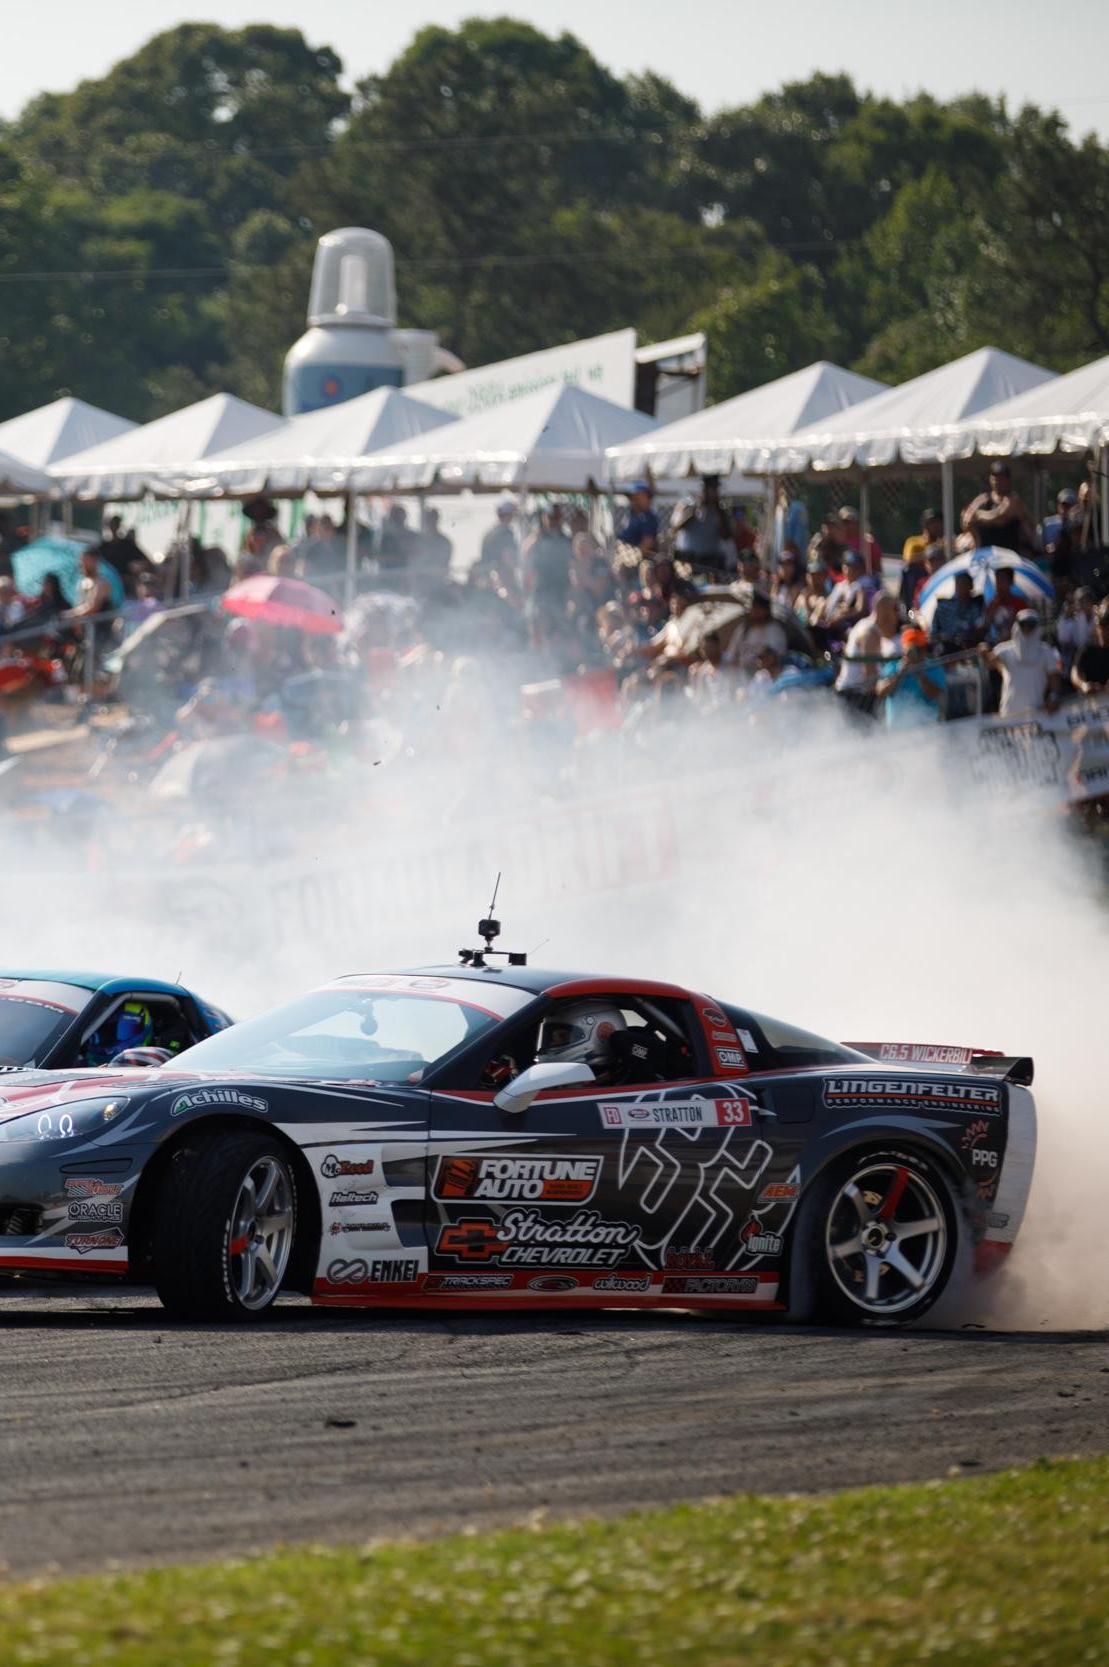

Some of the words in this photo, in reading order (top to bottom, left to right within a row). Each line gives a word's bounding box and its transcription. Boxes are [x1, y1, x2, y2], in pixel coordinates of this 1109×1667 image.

[719, 1051, 742, 1064] OMP
[881, 1044, 909, 1061] C6.5
[828, 1080, 999, 1102] LINGENFELTER
[173, 1090, 266, 1114] Achilles
[653, 1106, 703, 1123] STRATTON
[723, 1101, 745, 1123] 33
[972, 1149, 998, 1167] PPG
[478, 1160, 598, 1181] FORTUNE
[330, 1192, 378, 1203] Haltech
[474, 1180, 544, 1199] AUTO
[69, 1202, 121, 1217] ORACLE
[497, 1211, 639, 1245] Stratton
[747, 1233, 781, 1253] ignite
[501, 1246, 626, 1265] CHEVROLET
[370, 1260, 420, 1282] ENKEI
[443, 1276, 512, 1286] TRACKSPEC
[593, 1275, 652, 1290] wilwood
